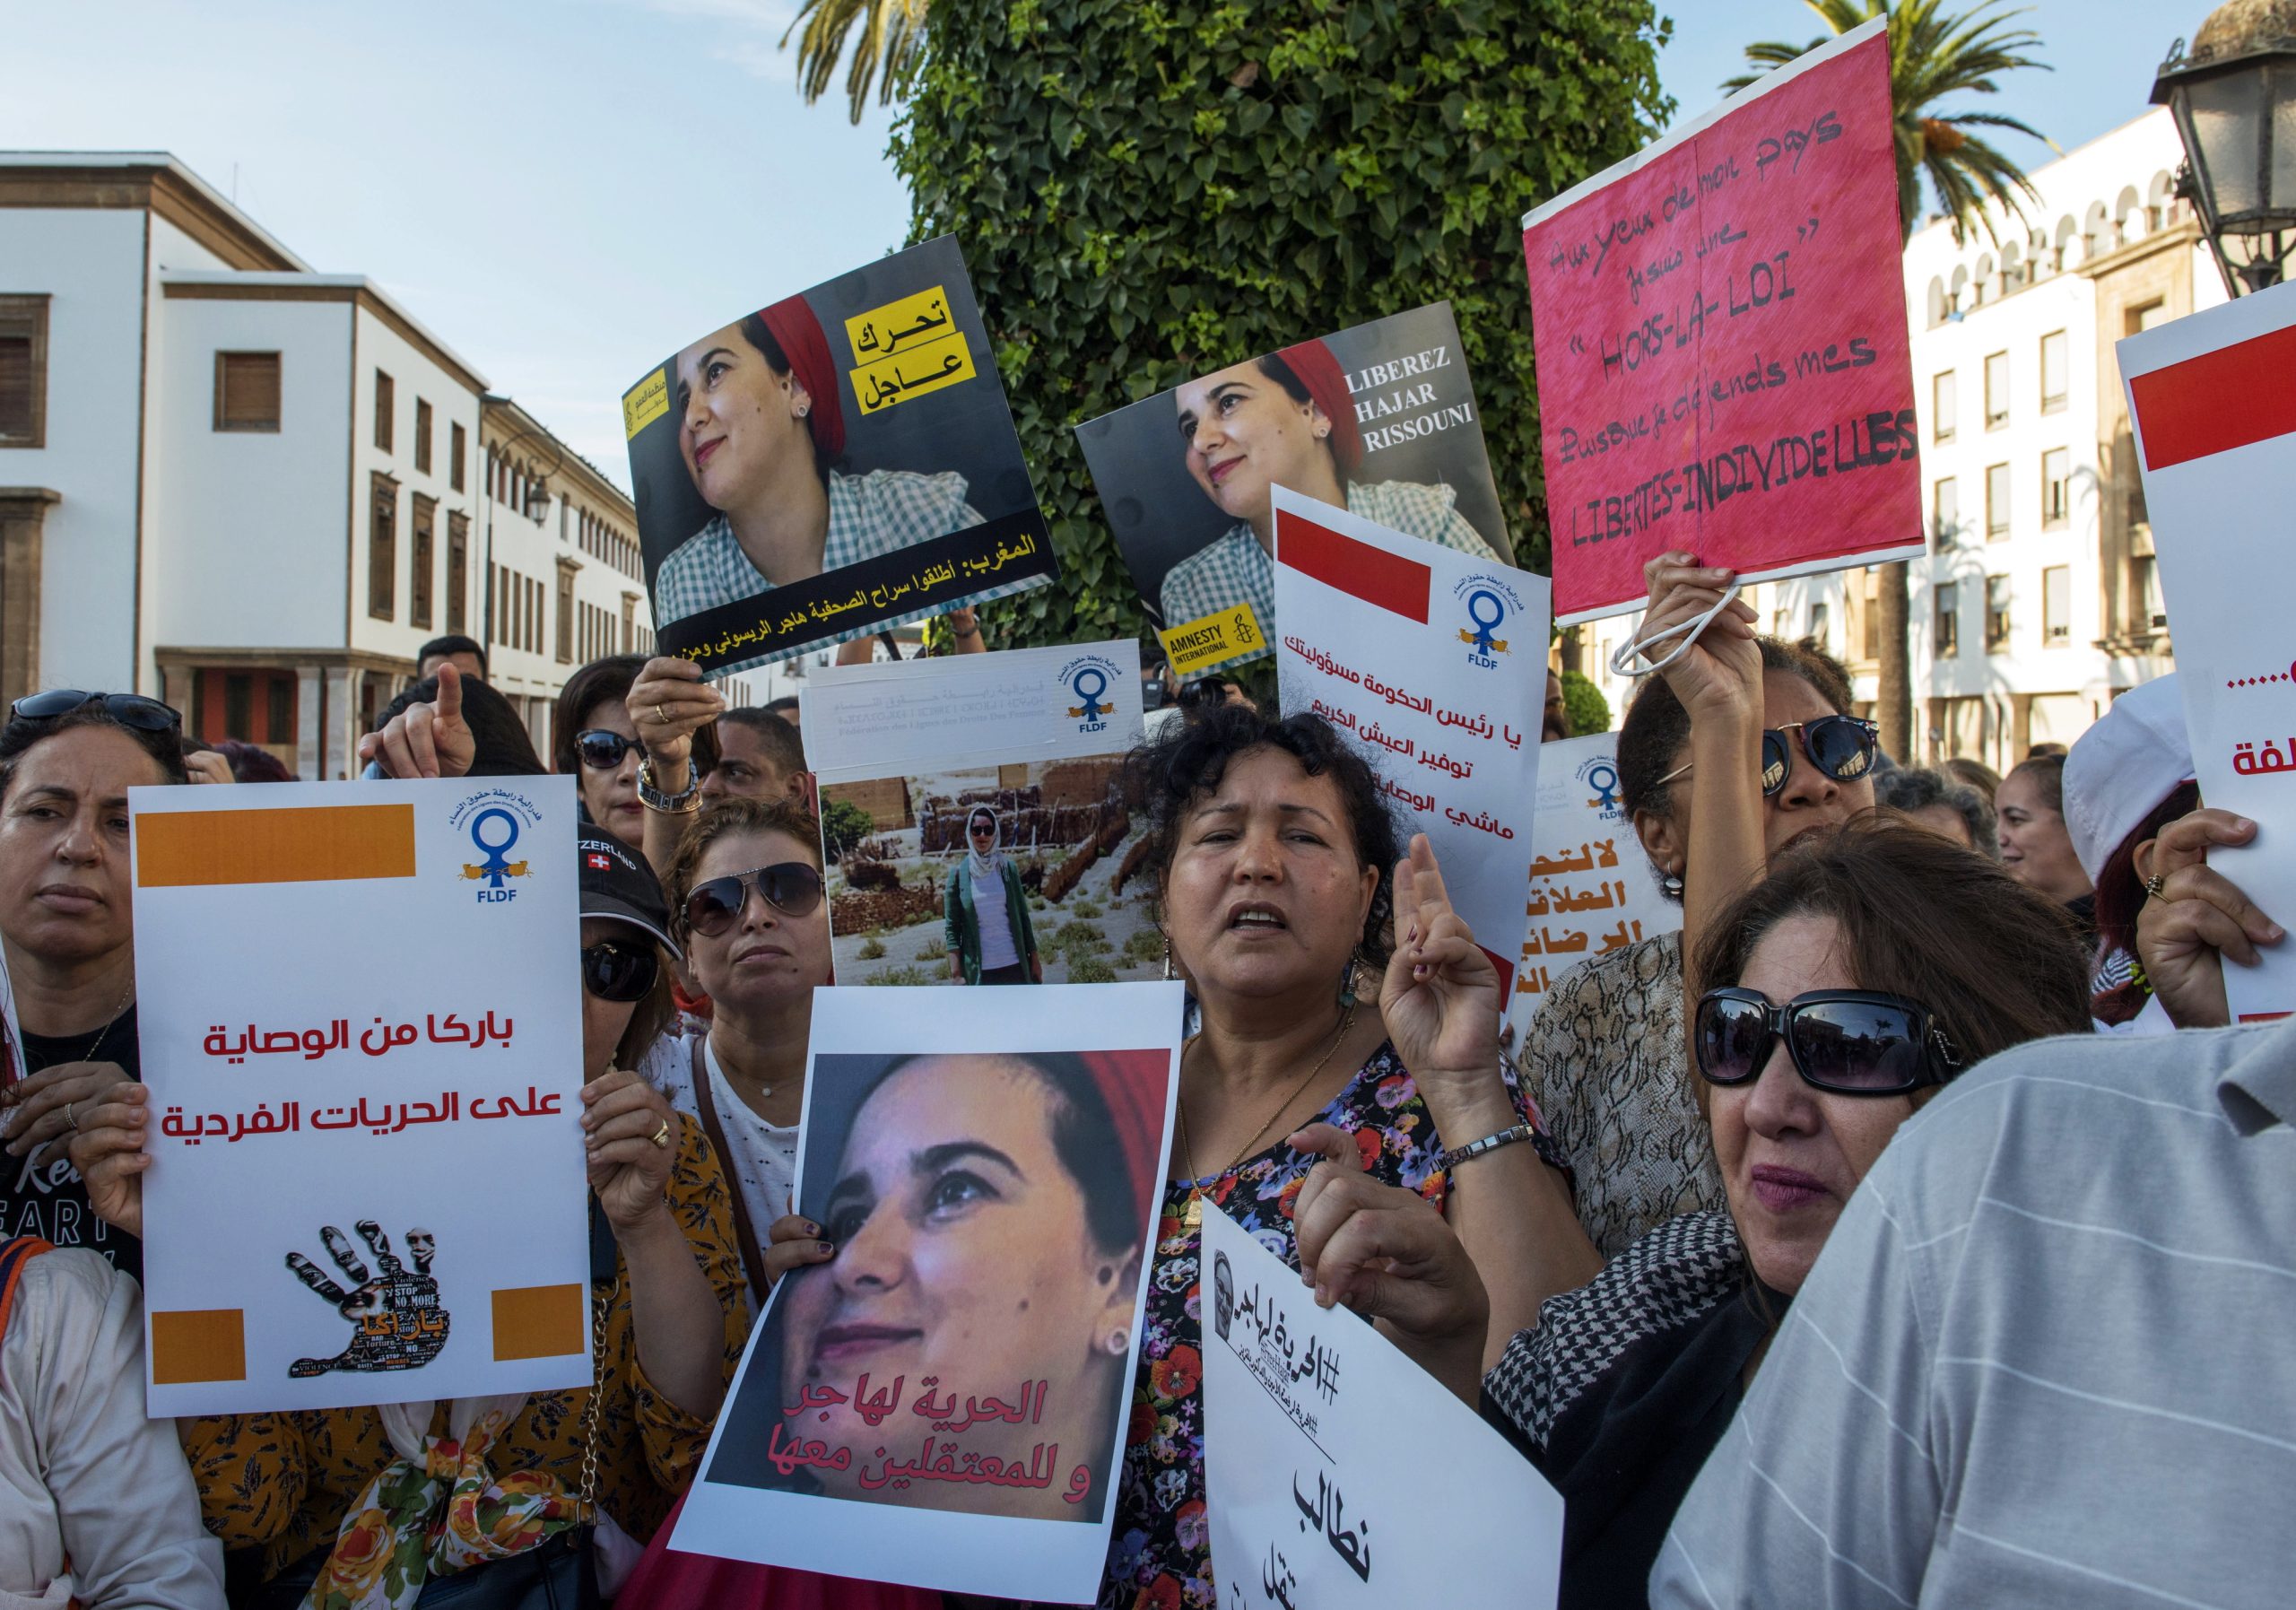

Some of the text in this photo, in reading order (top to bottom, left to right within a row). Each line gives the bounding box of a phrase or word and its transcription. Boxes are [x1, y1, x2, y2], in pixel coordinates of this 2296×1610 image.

[1550, 241, 1589, 274] Aux
[1663, 181, 1695, 222] de
[1699, 156, 1740, 195] mon
[1695, 223, 1748, 258] une
[858, 300, 947, 352] تحرك
[1343, 346, 1450, 394] LIBEREZ
[1793, 337, 1878, 381] mes
[865, 354, 962, 409] عاجل
[1353, 383, 1438, 423] HAJAR
[1362, 403, 1474, 452] RISSOUNI
[962, 534, 1036, 578] المغرب:
[912, 560, 956, 592] أطلقوا
[809, 589, 867, 622] الصحفية
[872, 583, 910, 608] سراح
[715, 620, 771, 655] الريسوني
[777, 612, 807, 634] هاجر
[1170, 624, 1222, 654] AMNESTY
[1175, 641, 1228, 665] INTERNATIONAL
[1468, 654, 1497, 671] FLDF
[1284, 636, 1521, 750] يا رئيس الحكومة مسؤوليتك
[1079, 722, 1107, 733] FLDF
[1360, 721, 1414, 757] العيش
[1418, 750, 1474, 779] توفير
[1445, 807, 1514, 840] ماشي
[578, 840, 637, 870] ZERLAND
[477, 890, 517, 903] FLDF
[203, 1010, 513, 1065] باركا من الوصاية
[161, 1086, 561, 1146] على الحريات الفردية
[395, 1287, 418, 1295] STOP
[395, 1294, 437, 1308] NO MORE
[405, 1345, 418, 1353] NO
[782, 1372, 1048, 1432] الحرية لهاجر
[767, 1423, 852, 1475] معها
[859, 1436, 1058, 1490] للمعتقلين
[1292, 1469, 1370, 1584] نطالب
